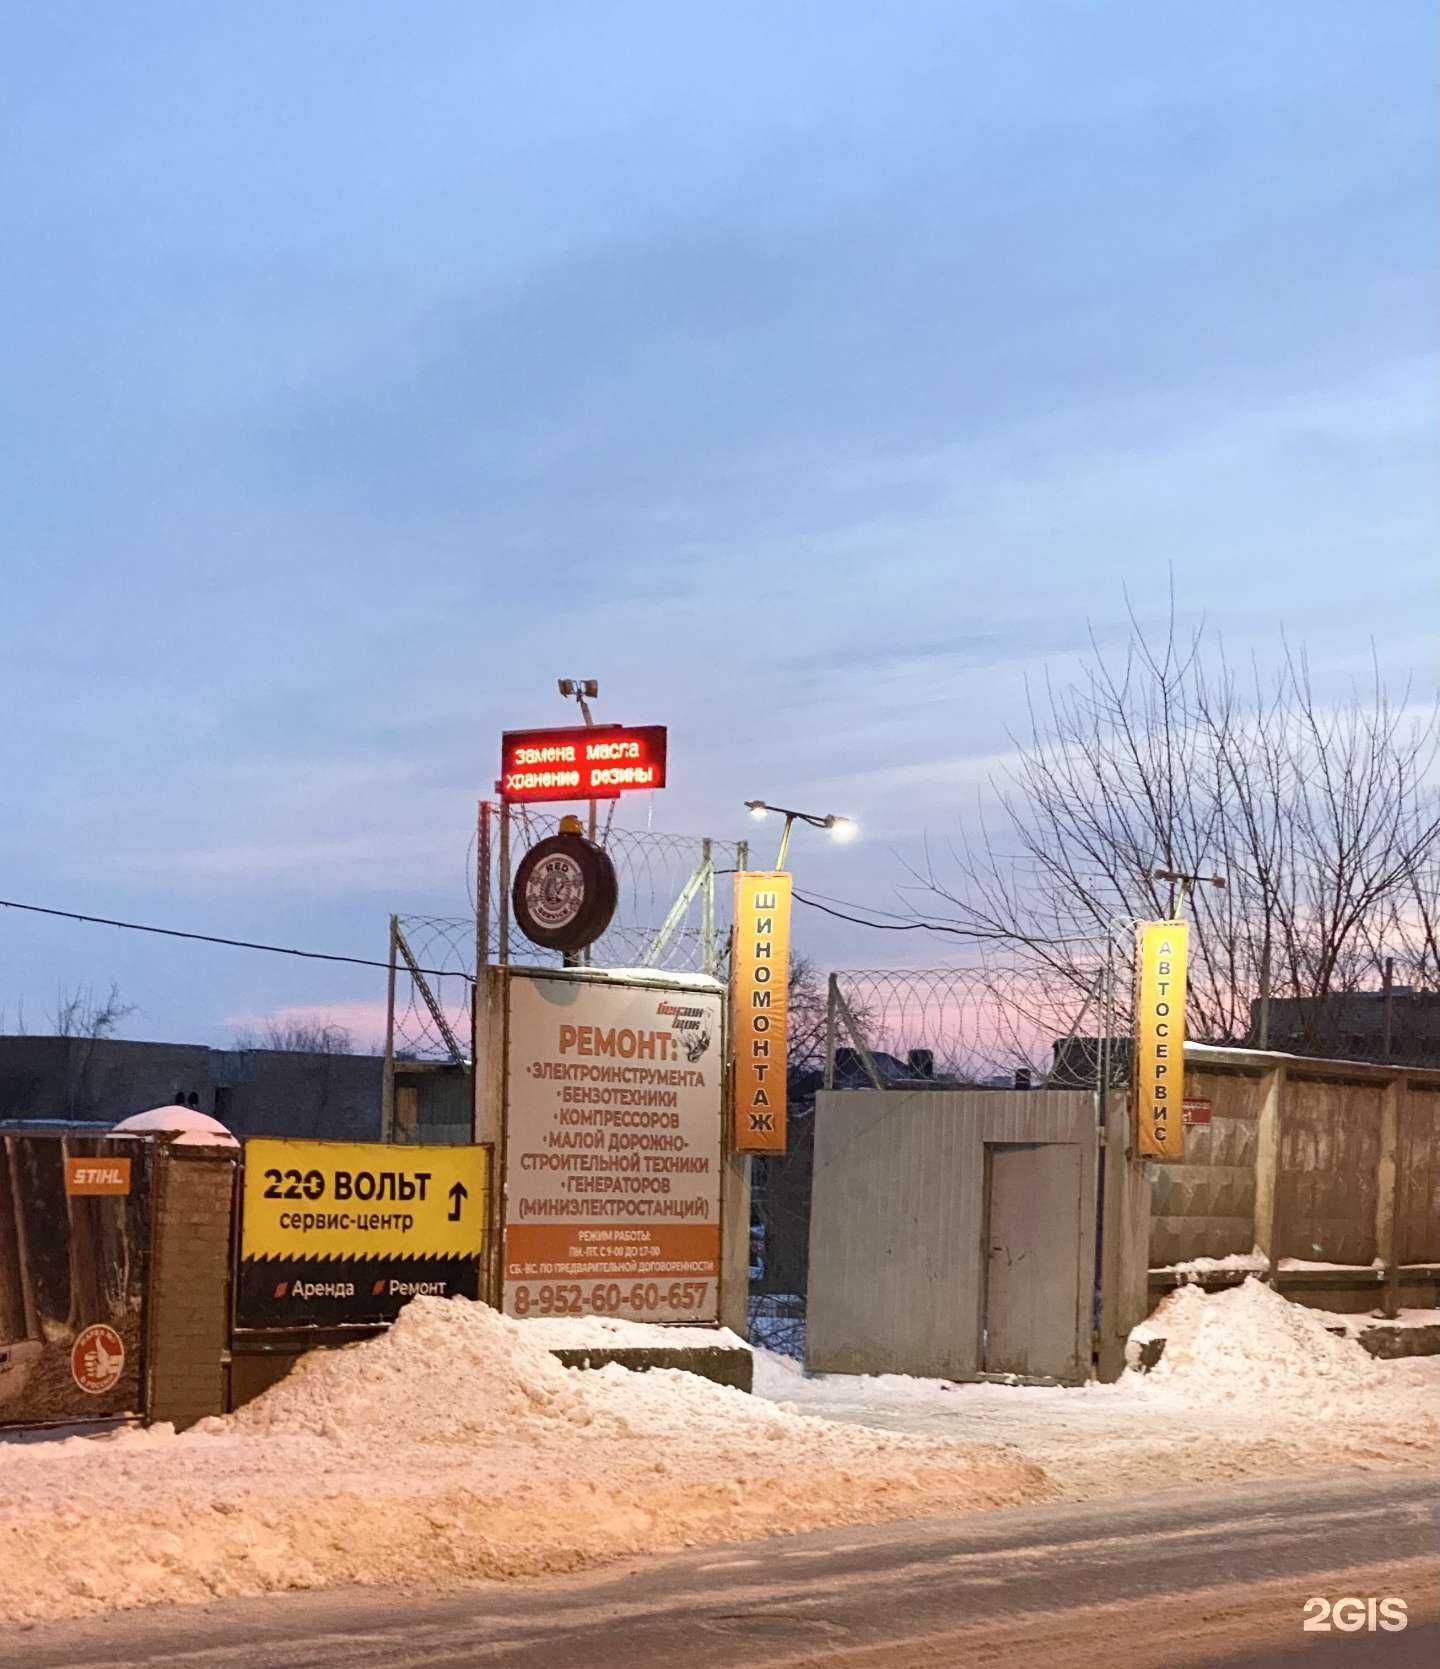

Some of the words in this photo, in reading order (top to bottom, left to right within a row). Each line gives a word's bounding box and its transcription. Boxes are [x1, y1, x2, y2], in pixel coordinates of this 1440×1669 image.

[514, 745, 576, 765] замена
[590, 767, 653, 787] резины
[750, 893, 776, 1131] ШИНОМОНТАЖ
[559, 1024, 678, 1061] РЕМОНТ:
[1154, 941, 1173, 1142] АВТОСЕРВИС
[532, 1062, 706, 1087] ЭЛЕКТРОИНСТРУМЕНТА
[562, 1086, 678, 1108] БЕНЗОТЕХНИКИ
[559, 1108, 680, 1130] КОМПРЕССОРОВ
[549, 1130, 605, 1150] МАЛОЙ
[608, 1133, 690, 1152] ДОРОЖНО-
[520, 1153, 641, 1173] СТРОИТЕЛЬНОЙ
[643, 1156, 709, 1173] ТЕХНИКИ
[73, 1169, 124, 1185] STIHL
[264, 1169, 325, 1200] 220
[334, 1171, 432, 1201] ВОЛЬТ
[566, 1175, 671, 1194] ГЕНЕРАТОРОВ
[518, 1197, 710, 1220] (МИНИЭЛЕКТРОСТАНЦИЙ)
[279, 1212, 414, 1234] сервис-центр
[291, 1280, 355, 1298] Аренда
[389, 1279, 447, 1296] Ремонт
[514, 1281, 709, 1315] 8-952-60-60-657
